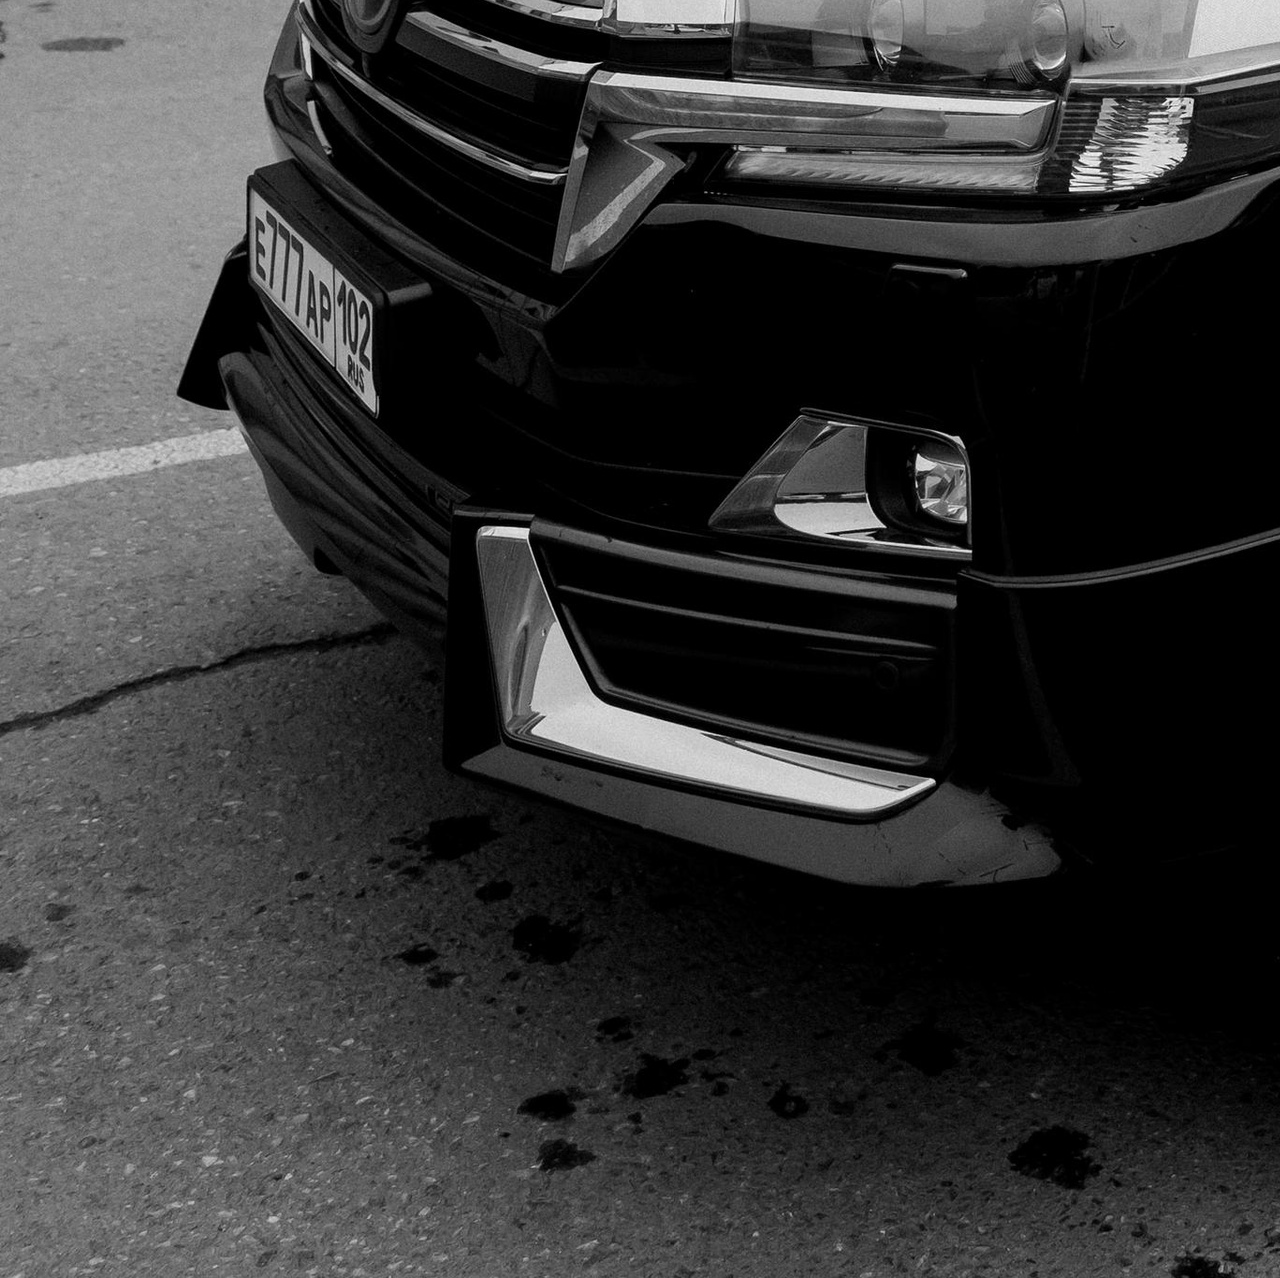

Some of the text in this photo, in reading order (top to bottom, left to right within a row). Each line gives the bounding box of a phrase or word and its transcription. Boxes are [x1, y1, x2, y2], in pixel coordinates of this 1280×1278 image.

[255, 210, 371, 372] E777AP 102
[347, 354, 365, 393] RUS
